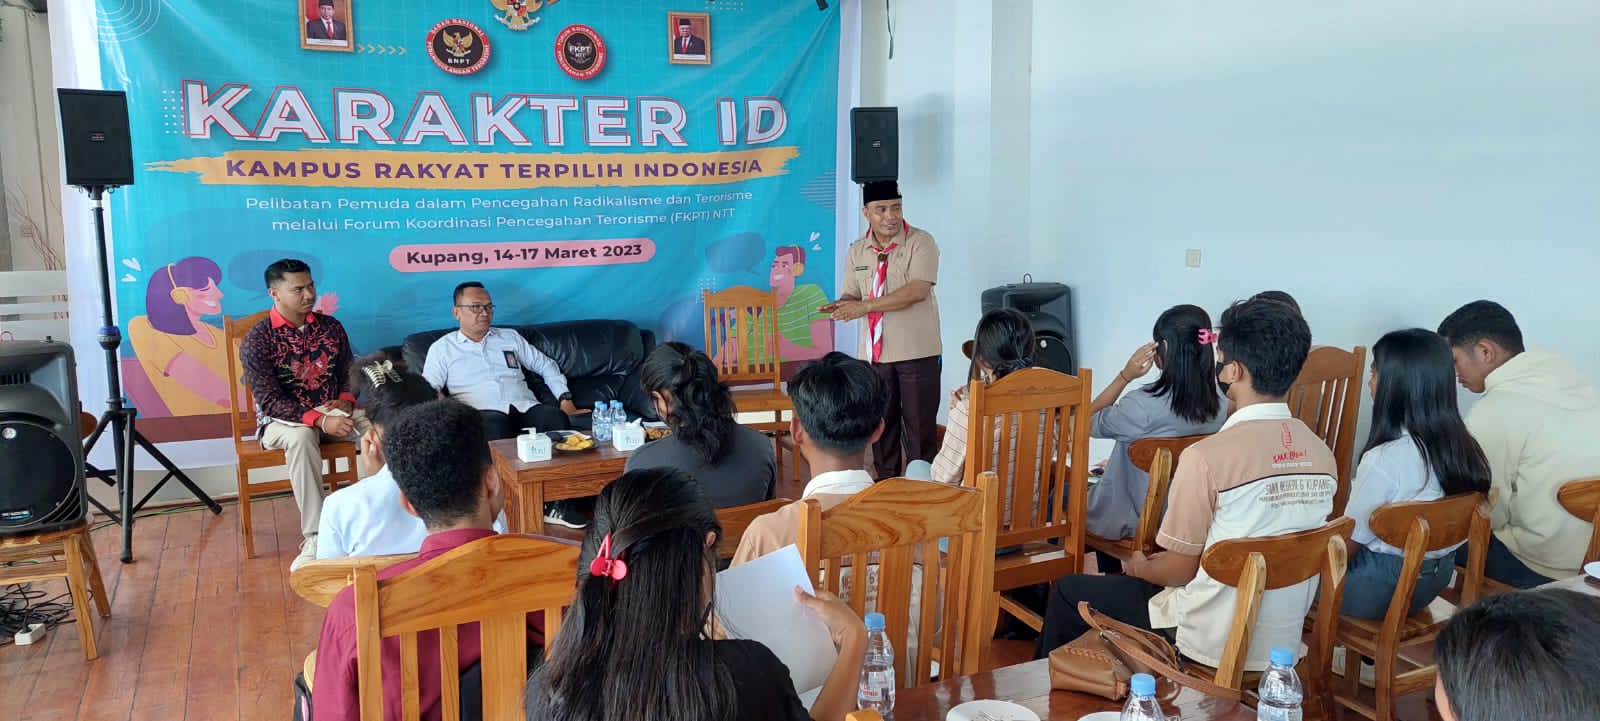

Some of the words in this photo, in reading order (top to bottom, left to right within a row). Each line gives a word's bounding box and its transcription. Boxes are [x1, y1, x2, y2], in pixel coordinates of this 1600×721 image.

[569, 46, 591, 54] FKPT
[182, 79, 688, 146] KARAKTER
[716, 96, 787, 146] ID
[226, 159, 361, 179] KAMPUS
[374, 162, 489, 179] RAKYAT
[500, 163, 623, 179] TERPILIH
[635, 159, 763, 177] INDONESIA
[245, 197, 332, 210] Pelibatan
[337, 198, 410, 209] Pemuda
[415, 197, 466, 209] dalam
[471, 196, 568, 211] Pencegahan
[573, 195, 662, 208] Radikalisme
[666, 194, 691, 205] dan
[695, 191, 753, 204] Terorisme
[271, 218, 338, 231] melalui
[344, 218, 400, 230] Forum
[406, 217, 491, 229] Koordinasi
[496, 214, 592, 229] Pencegahan
[596, 213, 667, 226] Terorisme
[670, 210, 711, 225] (FKPT)
[713, 207, 736, 219] NTT
[406, 251, 489, 266] Kupang,
[494, 247, 539, 261] 14-17
[544, 246, 597, 260] Maret
[602, 244, 642, 257] 2023
